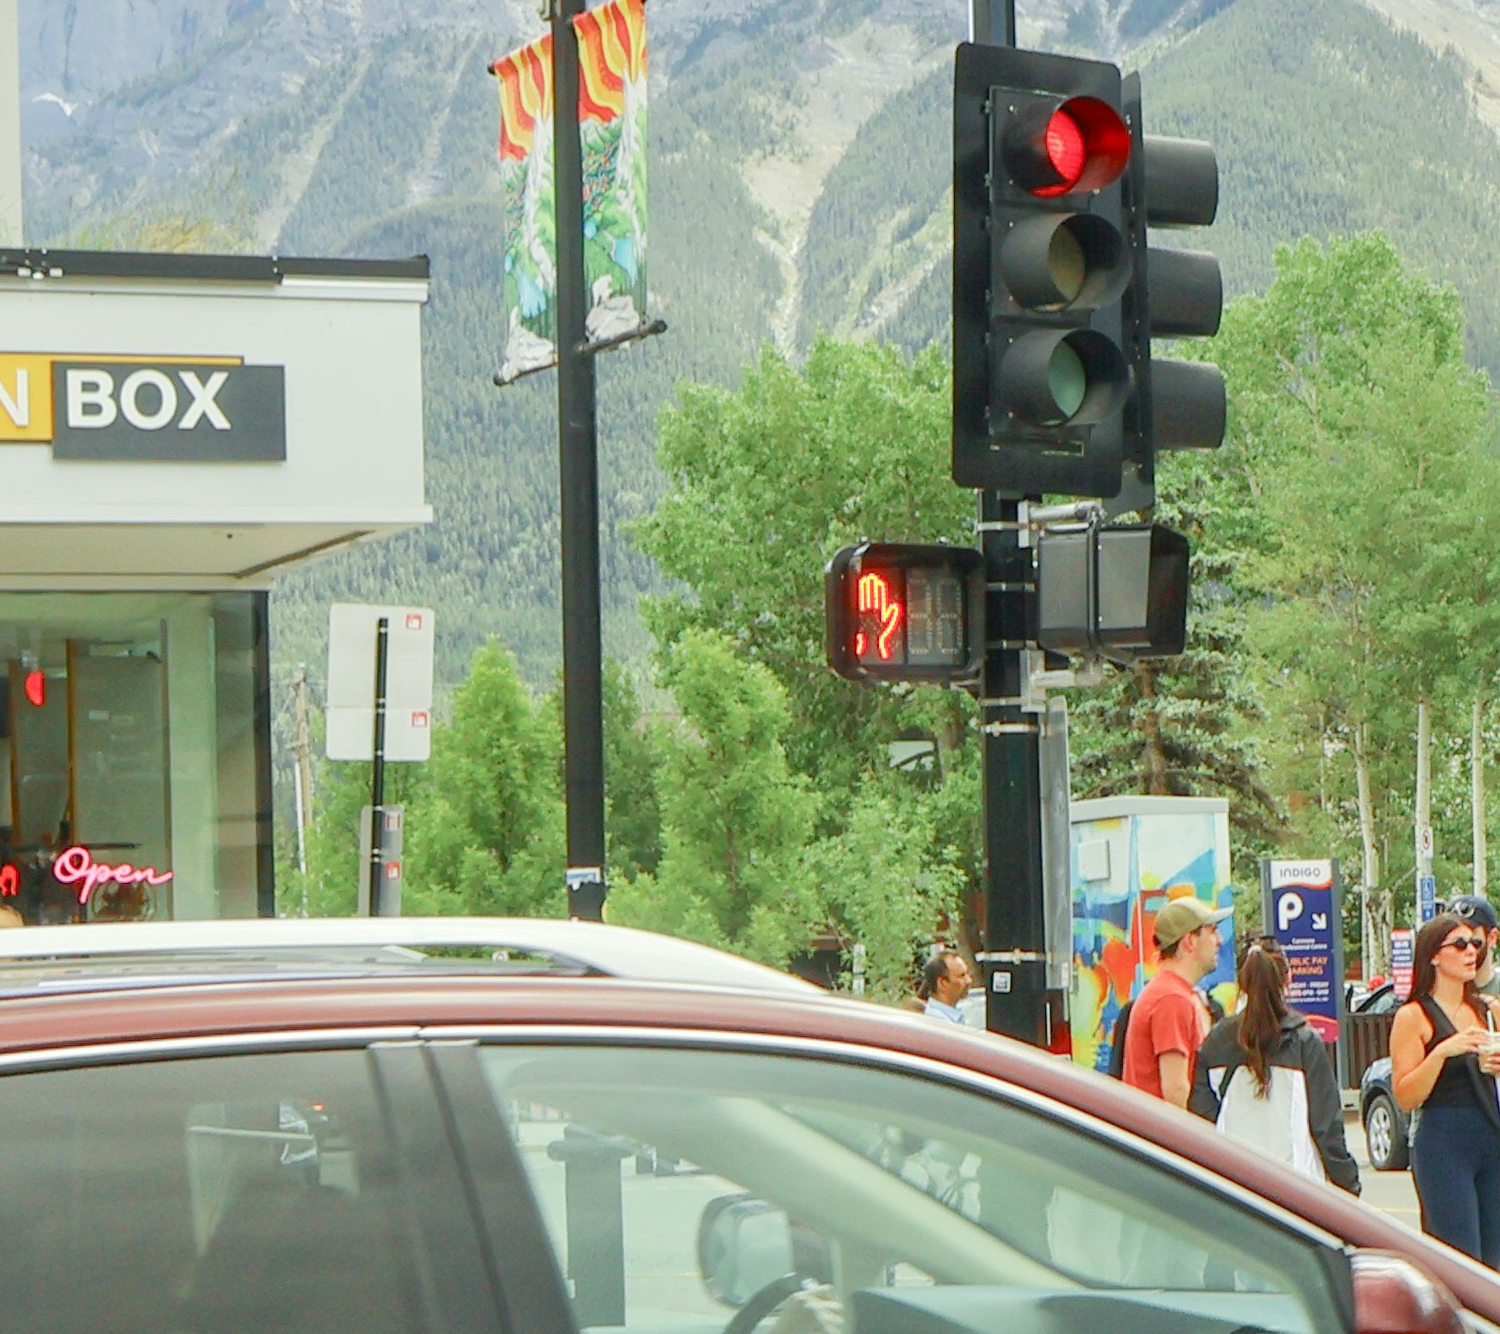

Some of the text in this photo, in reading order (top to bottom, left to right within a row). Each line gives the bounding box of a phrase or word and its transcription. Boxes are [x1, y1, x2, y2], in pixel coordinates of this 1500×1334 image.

[66, 369, 232, 430] BOX
[53, 846, 174, 905] Open
[1279, 867, 1321, 878] INDIGO
[1278, 891, 1303, 931] P
